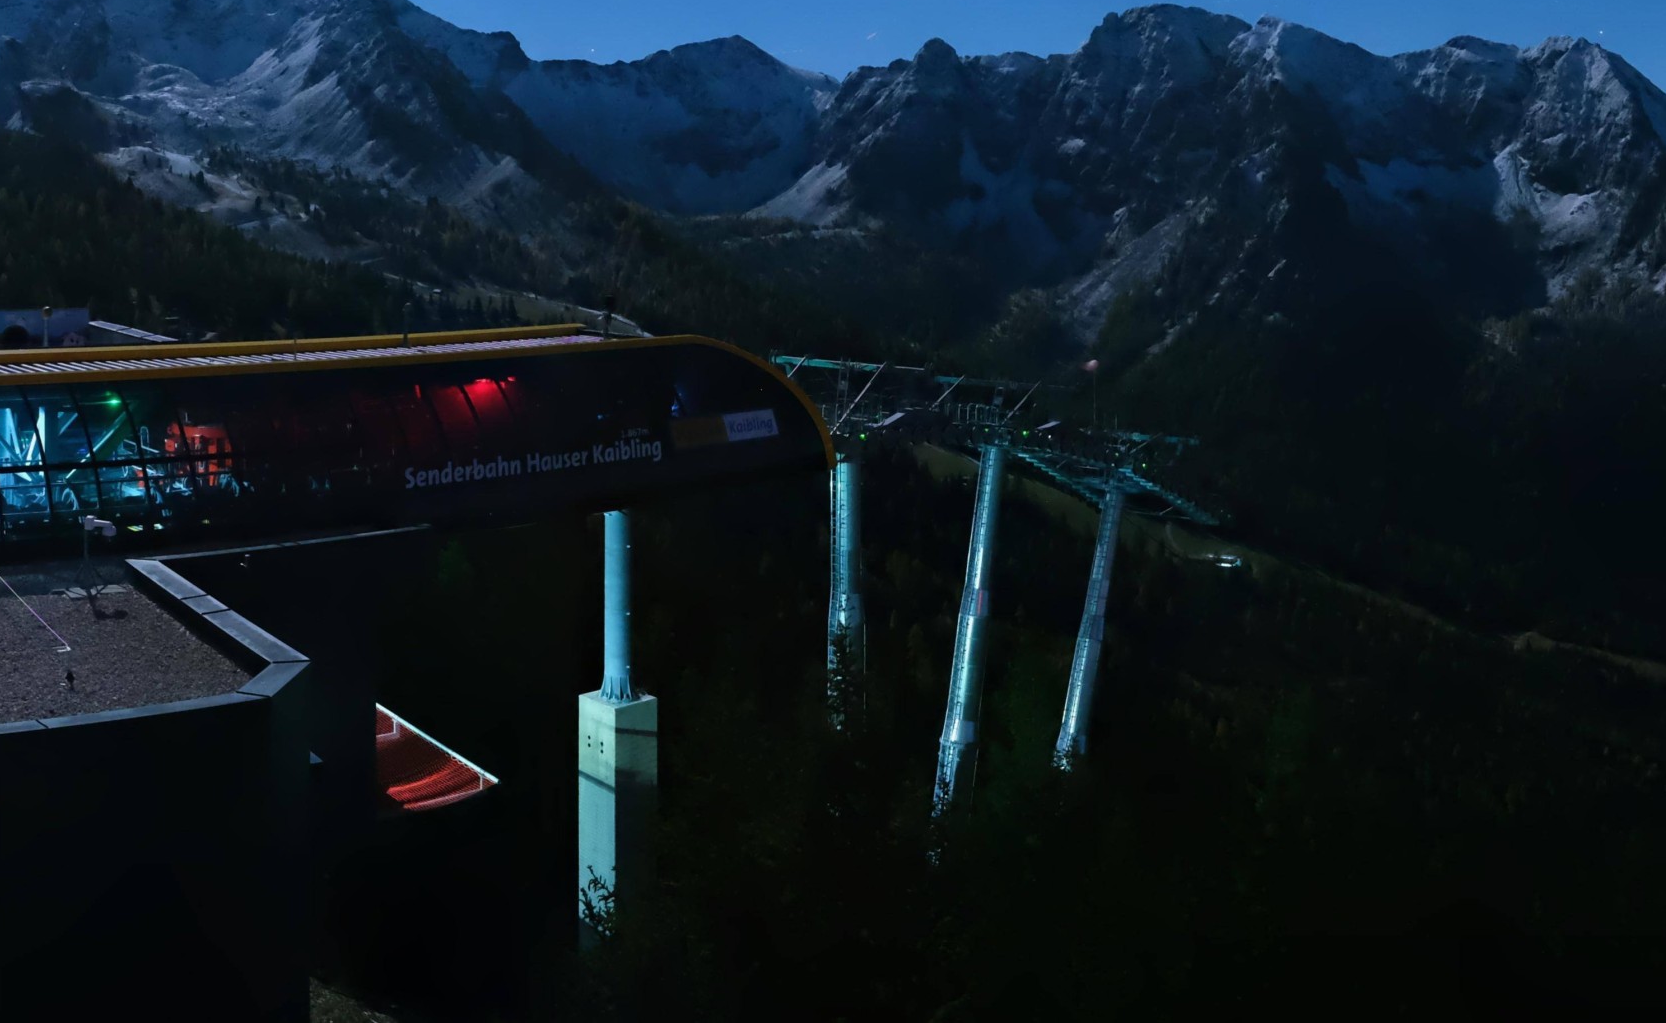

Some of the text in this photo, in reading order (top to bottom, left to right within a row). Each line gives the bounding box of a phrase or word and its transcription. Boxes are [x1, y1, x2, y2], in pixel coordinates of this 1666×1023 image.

[729, 417, 774, 434] Kaibling
[405, 438, 662, 489] Senderbahn Hauser Kaibling
